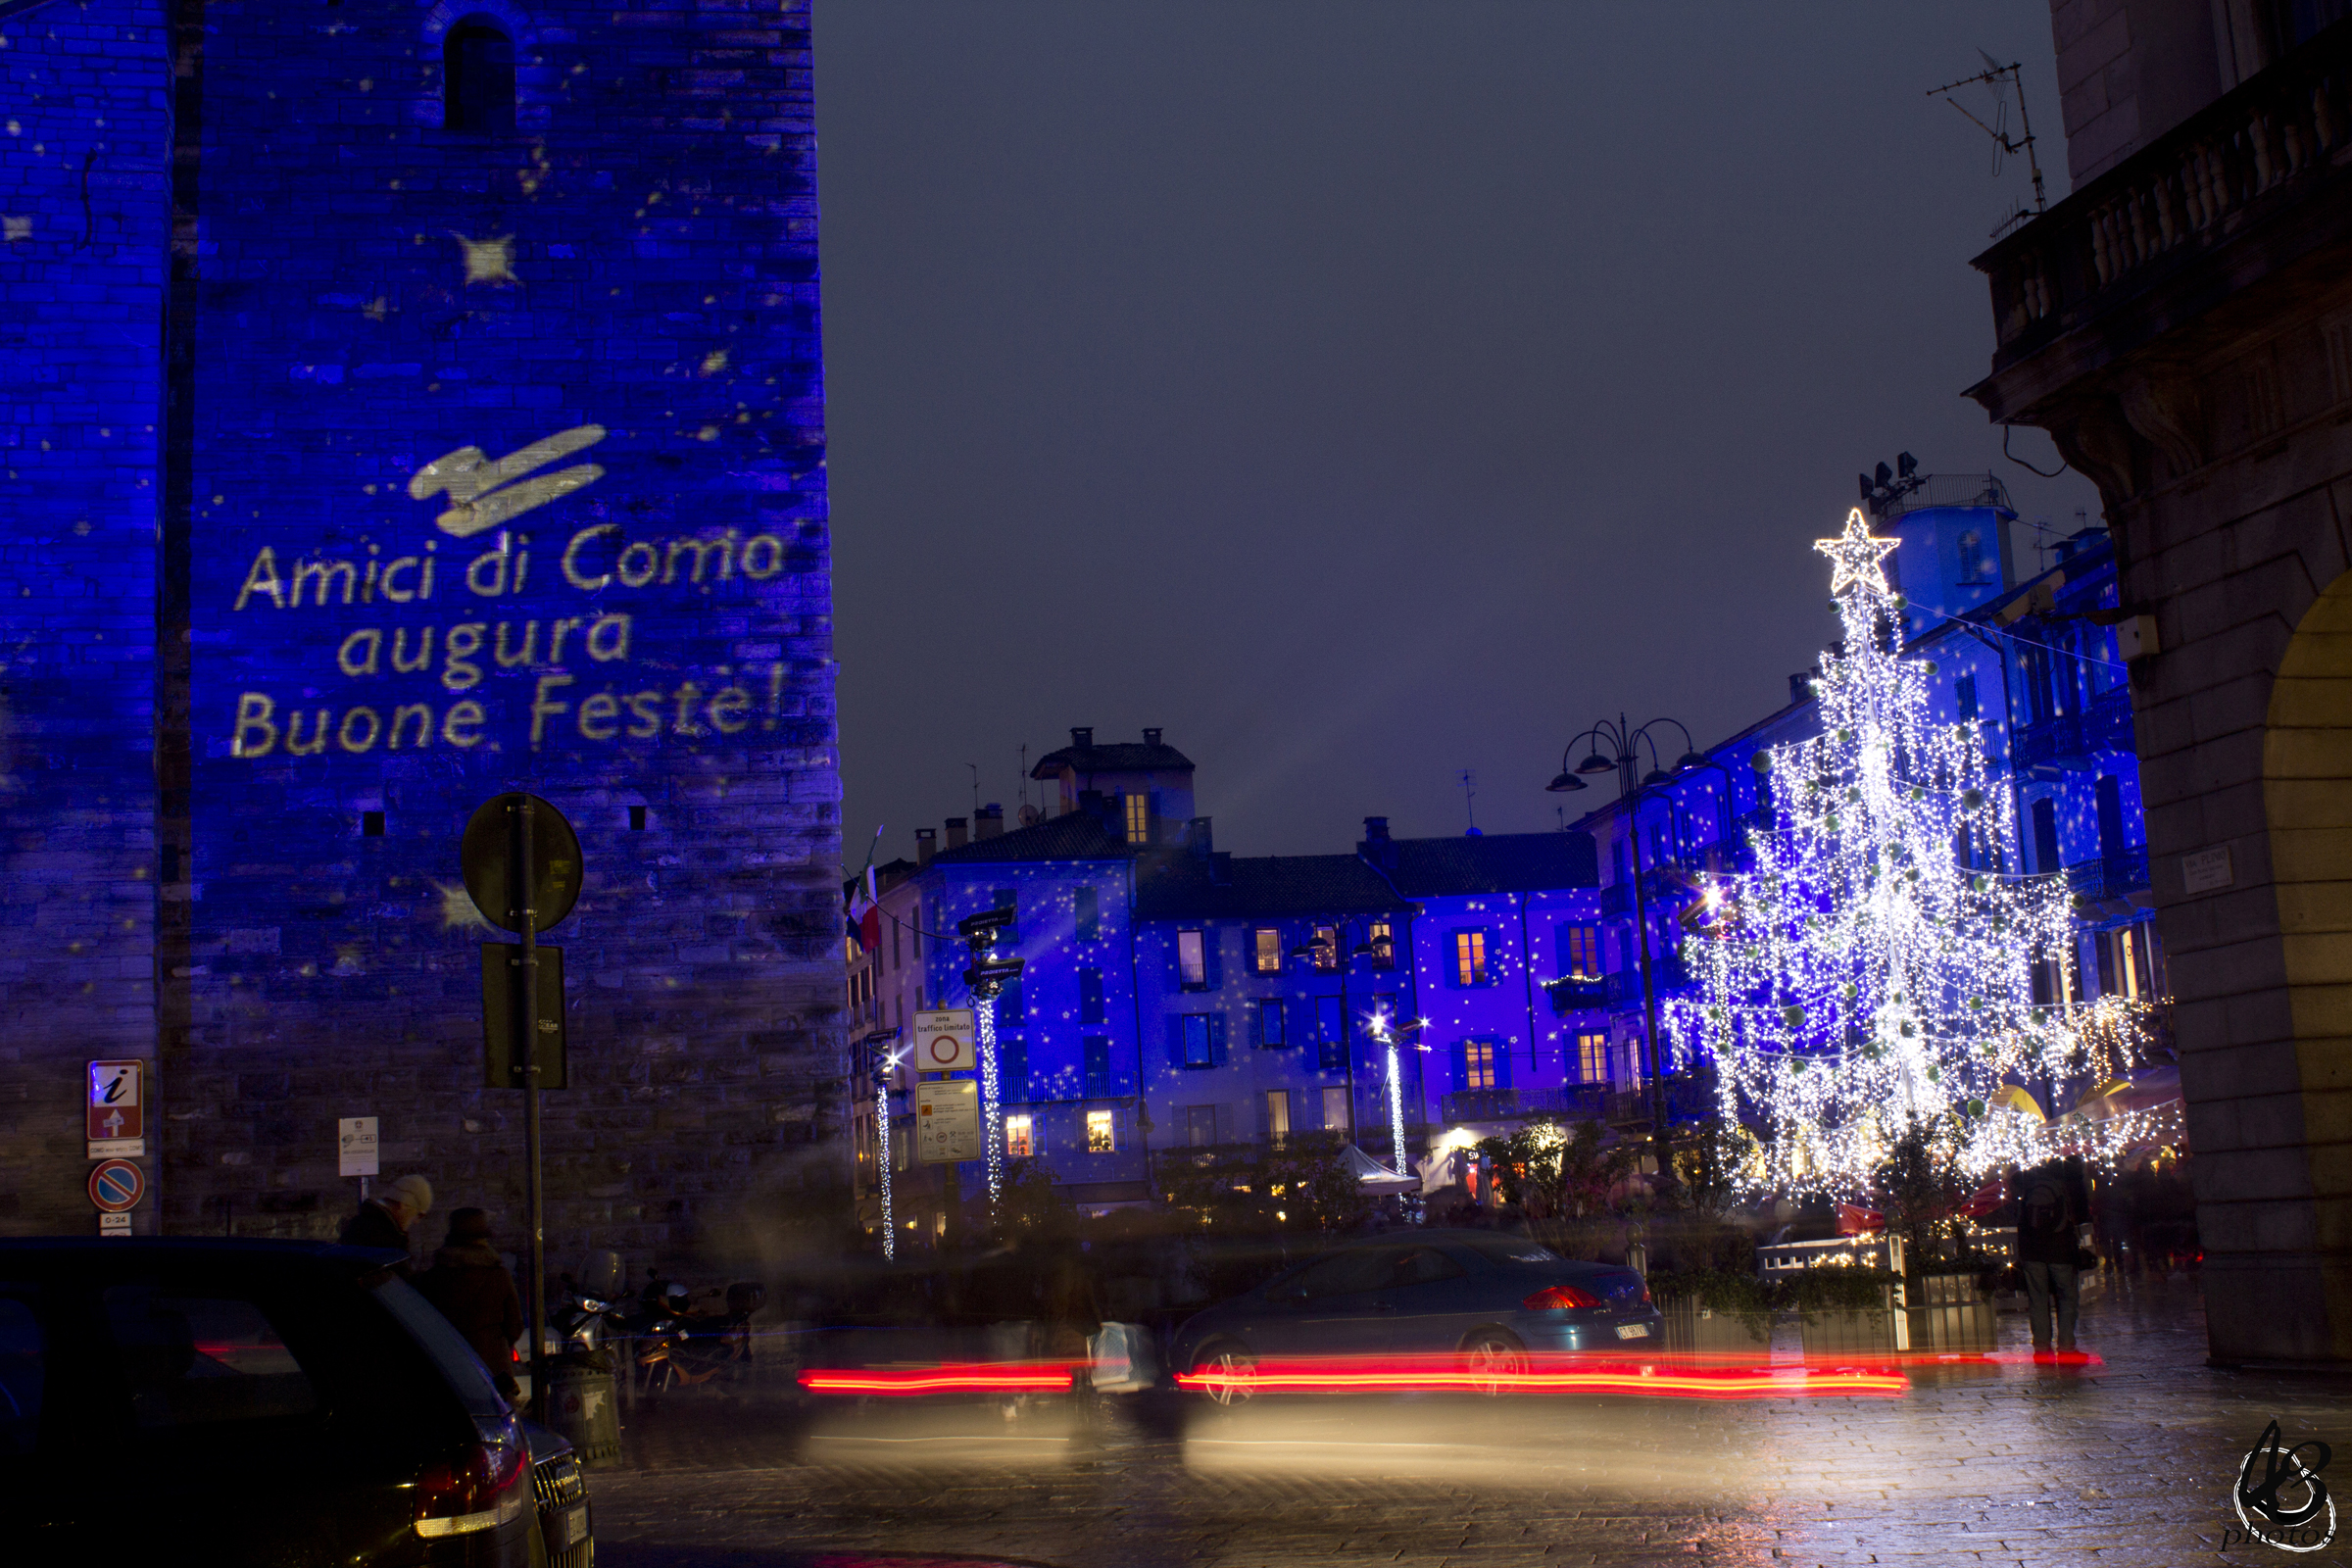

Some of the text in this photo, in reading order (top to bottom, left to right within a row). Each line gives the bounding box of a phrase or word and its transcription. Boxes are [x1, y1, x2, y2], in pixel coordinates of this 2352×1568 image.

[233, 523, 784, 611] Amici di Como
[336, 613, 633, 688] augura
[230, 663, 784, 759] Buone Feste!
[944, 1023, 970, 1032] limitato
